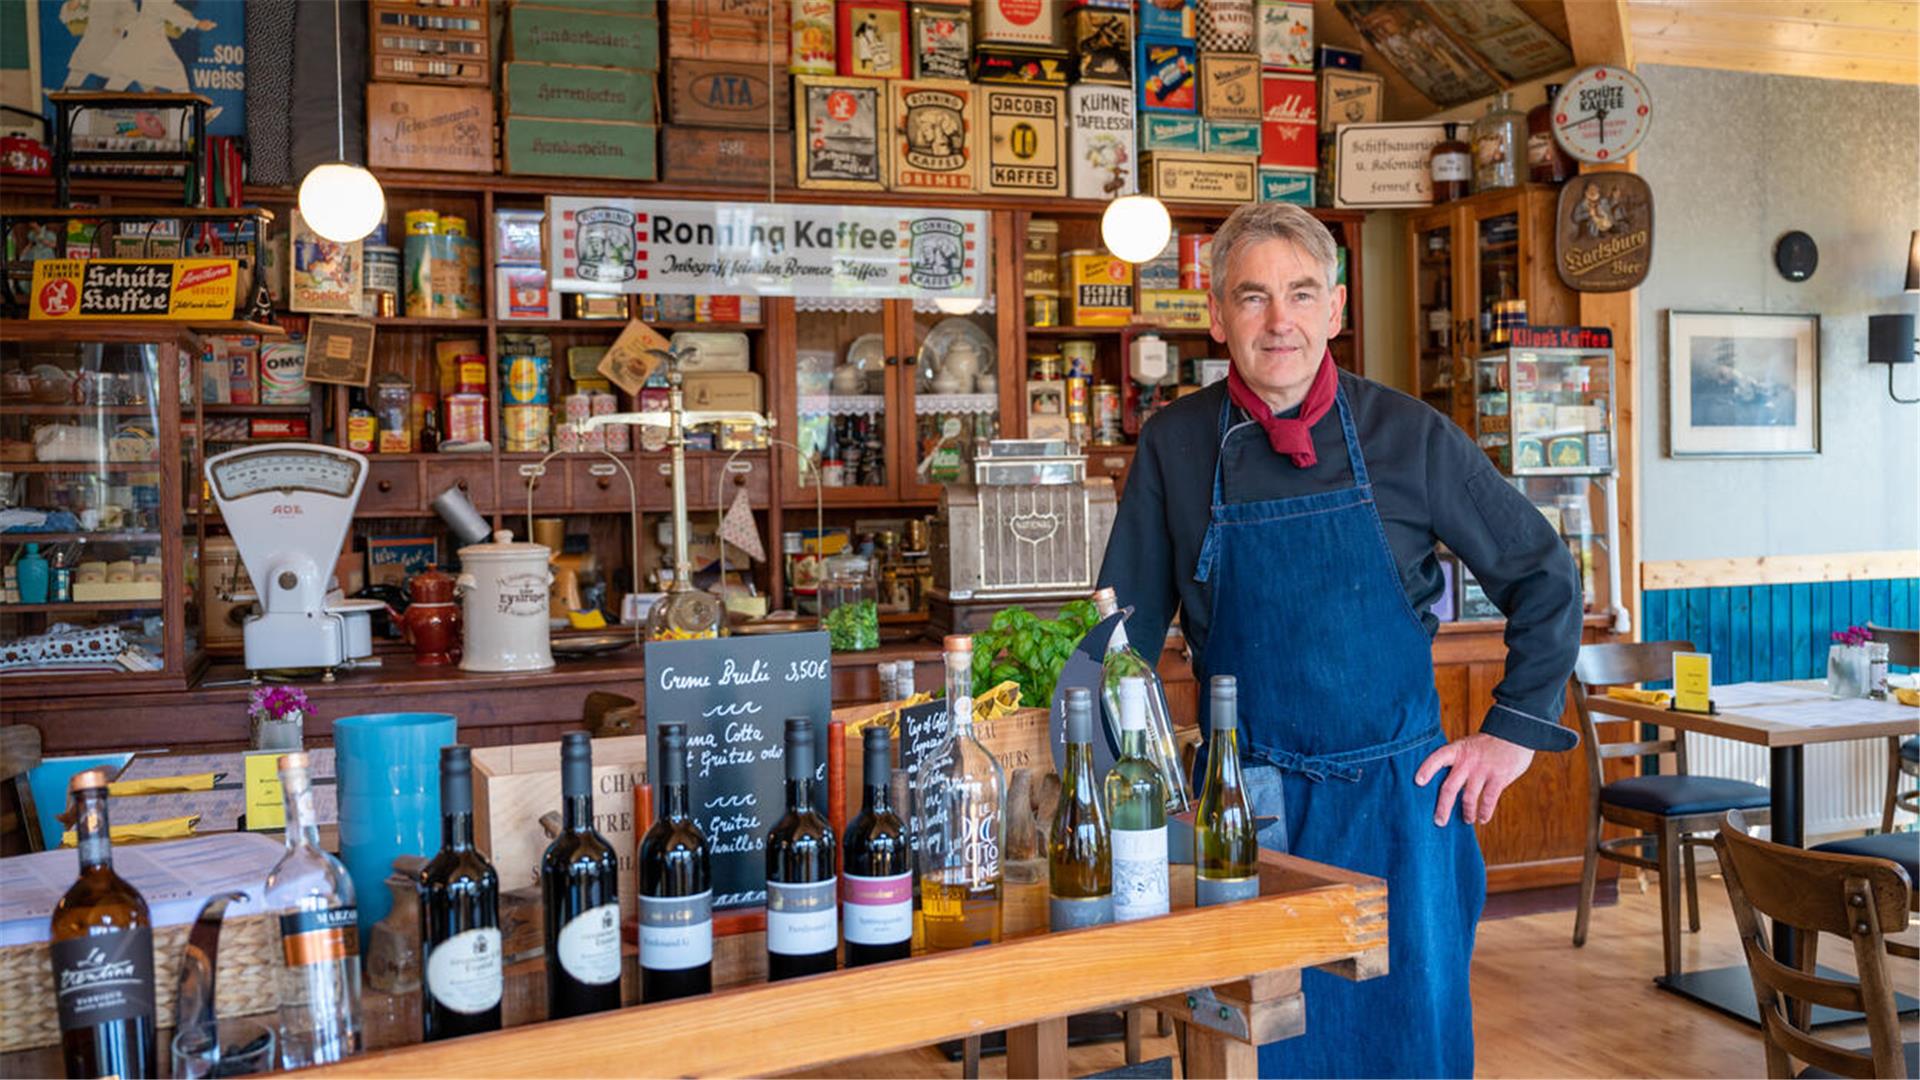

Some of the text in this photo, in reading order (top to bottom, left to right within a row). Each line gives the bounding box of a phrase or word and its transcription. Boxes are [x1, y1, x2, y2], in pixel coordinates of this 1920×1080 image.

[194, 66, 245, 89] weiss
[709, 76, 753, 106] ATA
[1580, 85, 1624, 101] SCHÜTZ
[994, 97, 1053, 113] JACOBS
[1080, 93, 1130, 116] KÜHNE
[1580, 99, 1624, 112] KAFFEE
[995, 169, 1054, 185] KAFFEE
[794, 219, 897, 249] Kaffee
[84, 265, 172, 288] Schütz
[1611, 259, 1643, 275] Bier
[81, 287, 168, 313] Kaffee
[1082, 296, 1128, 307] KAFFEE
[1560, 330, 1609, 347] Kaffee
[660, 667, 711, 690] Creme
[785, 659, 828, 682] 3,50€
[724, 721, 764, 743] Cotta
